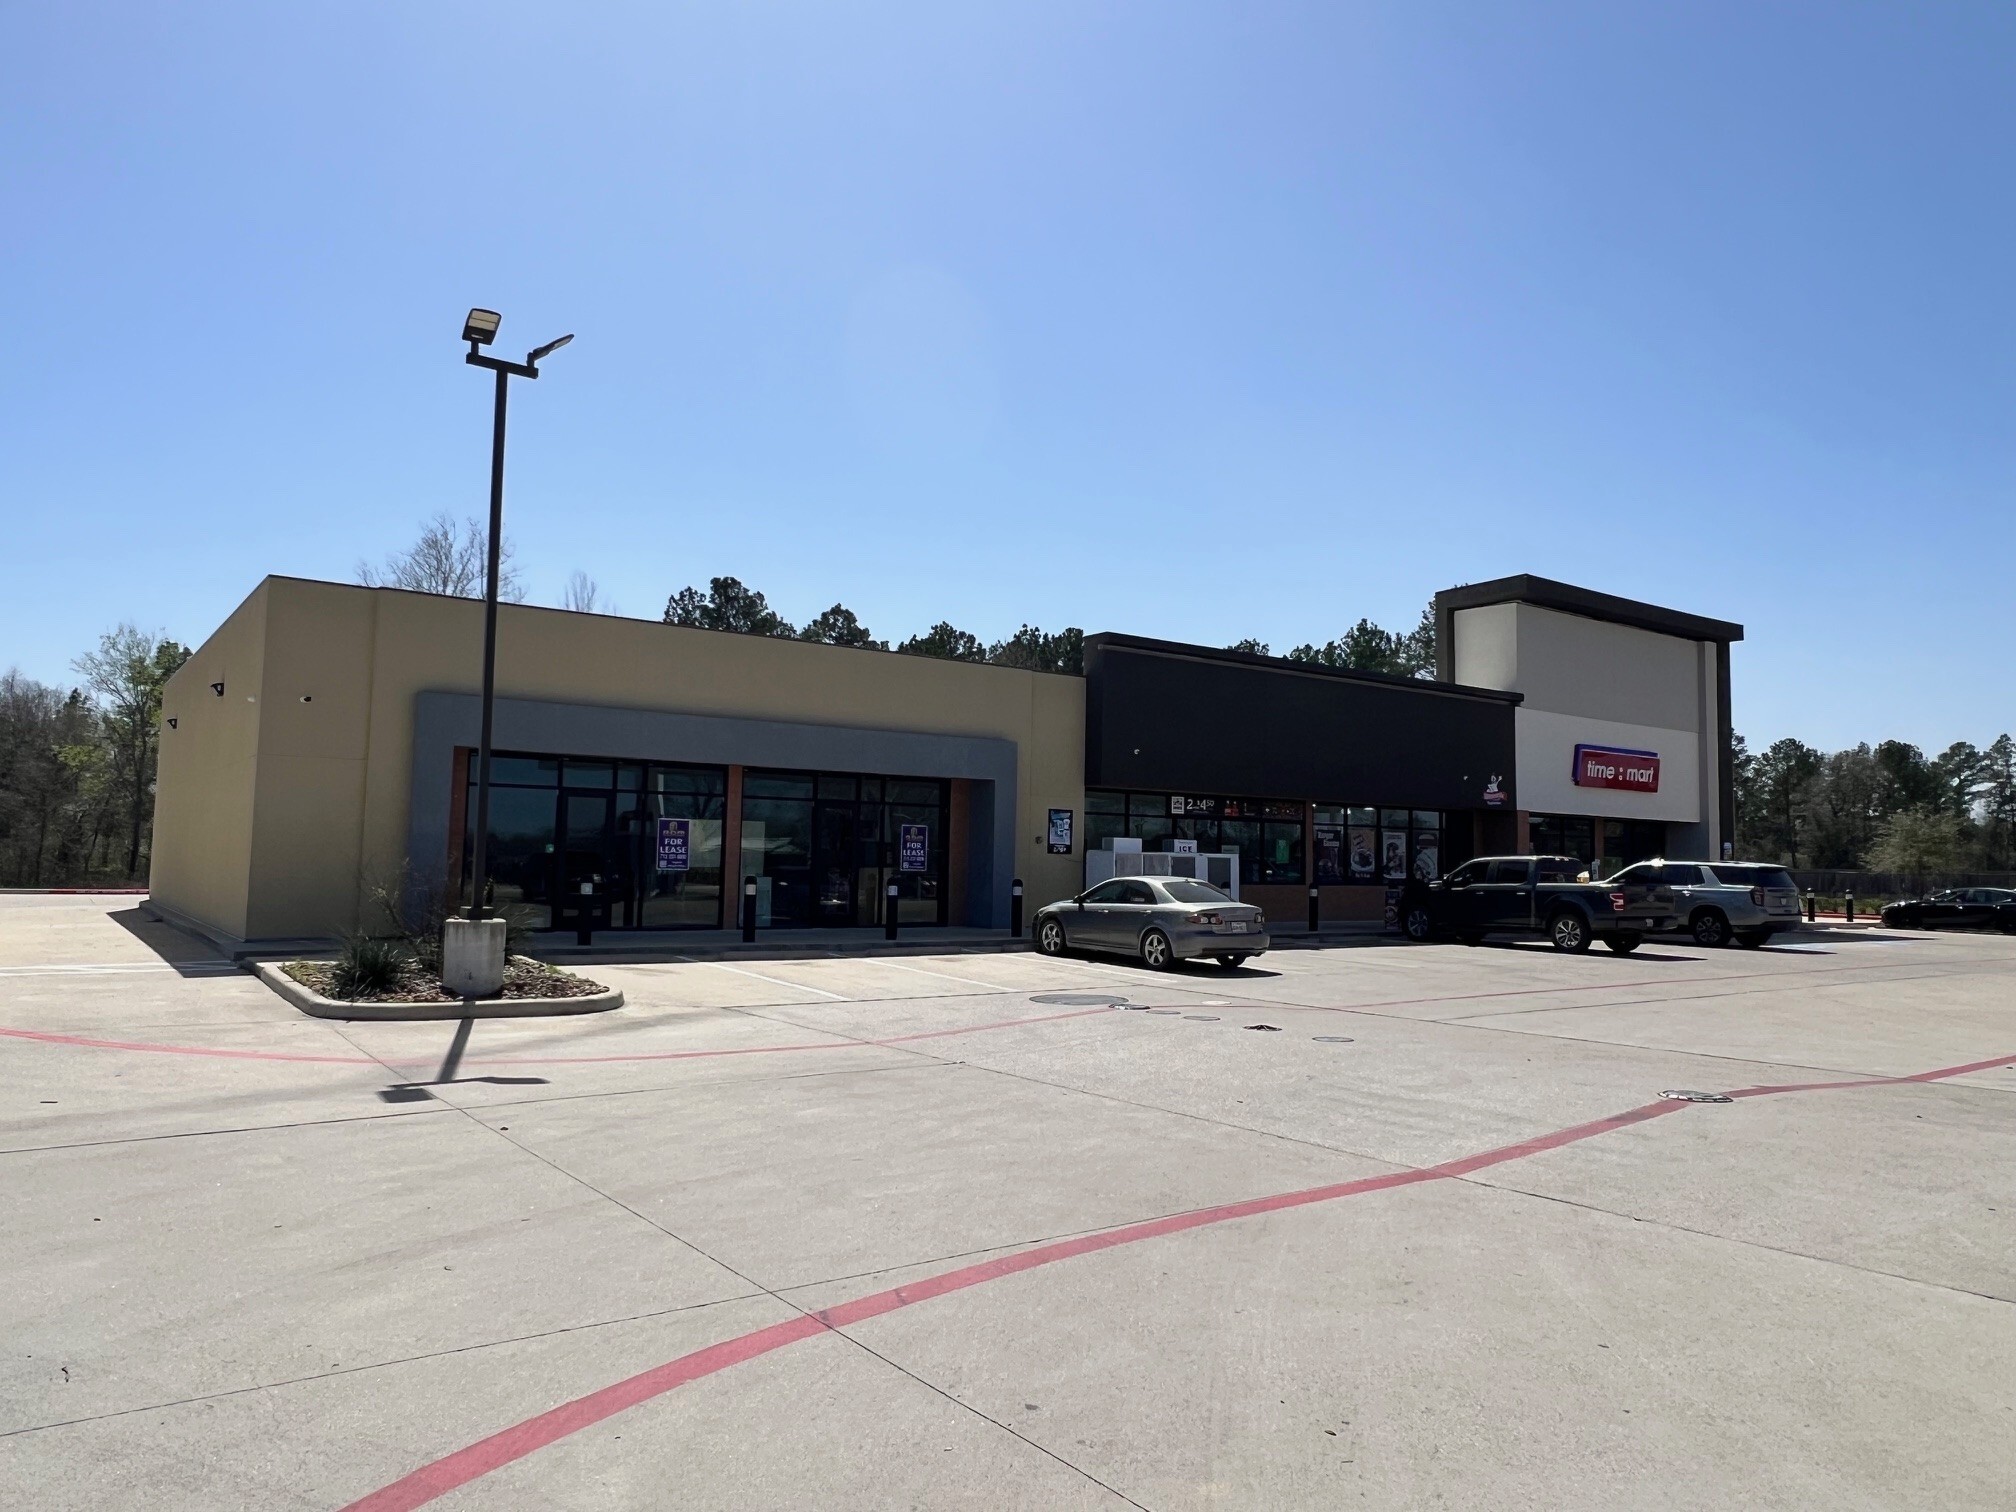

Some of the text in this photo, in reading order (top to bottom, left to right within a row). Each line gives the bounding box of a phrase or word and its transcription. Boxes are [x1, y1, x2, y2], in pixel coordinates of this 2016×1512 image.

[1587, 760, 1615, 779] time
[1626, 767, 1654, 782] mart
[660, 846, 687, 854] LEASE
[1179, 845, 1193, 853] ICE
